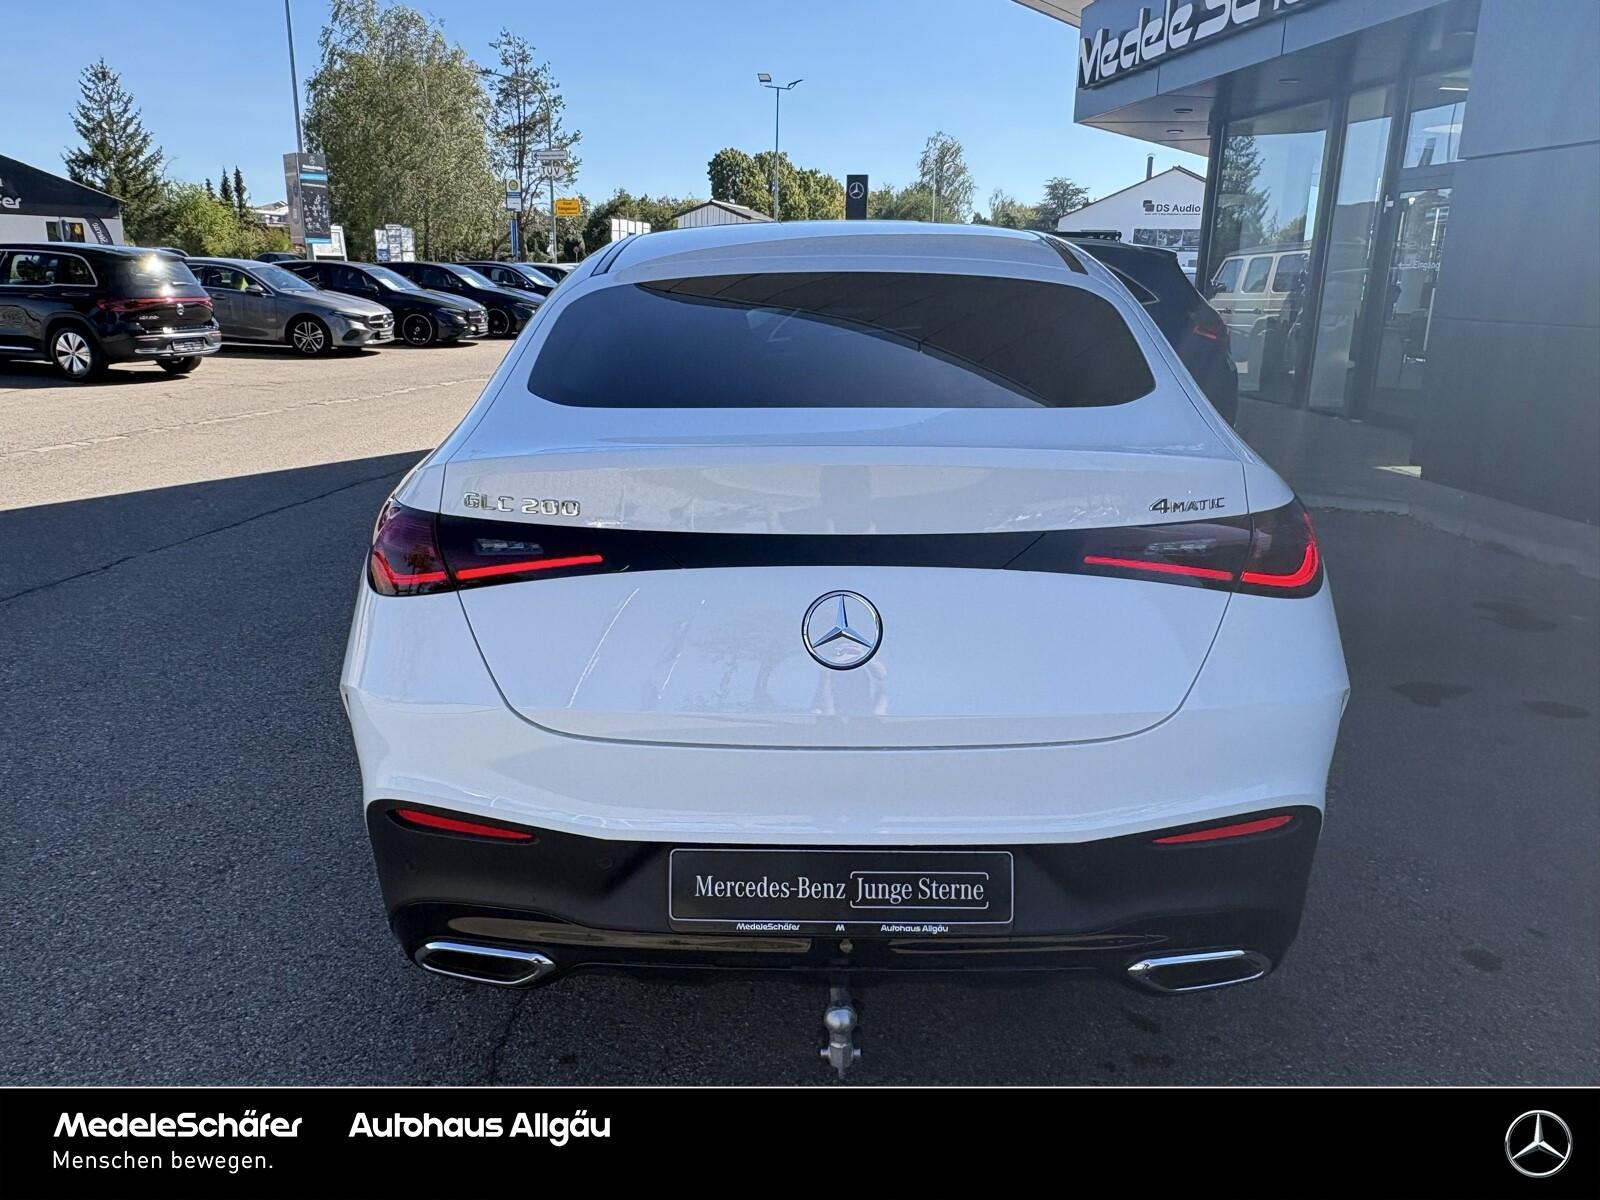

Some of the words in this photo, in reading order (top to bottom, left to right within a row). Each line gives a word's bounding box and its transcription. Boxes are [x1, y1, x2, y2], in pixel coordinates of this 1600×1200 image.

[0, 195, 22, 209] er
[1156, 204, 1170, 213] DS
[1172, 204, 1201, 213] Audio
[463, 491, 514, 513] GLC
[521, 497, 581, 517] 200
[694, 875, 846, 899] Mercedes-Benz
[855, 877, 912, 904] Junge
[918, 877, 984, 900] Sterne
[736, 922, 800, 931] MedeleSchäfer
[880, 924, 921, 933] Autohaus
[922, 924, 949, 934] Allgäu
